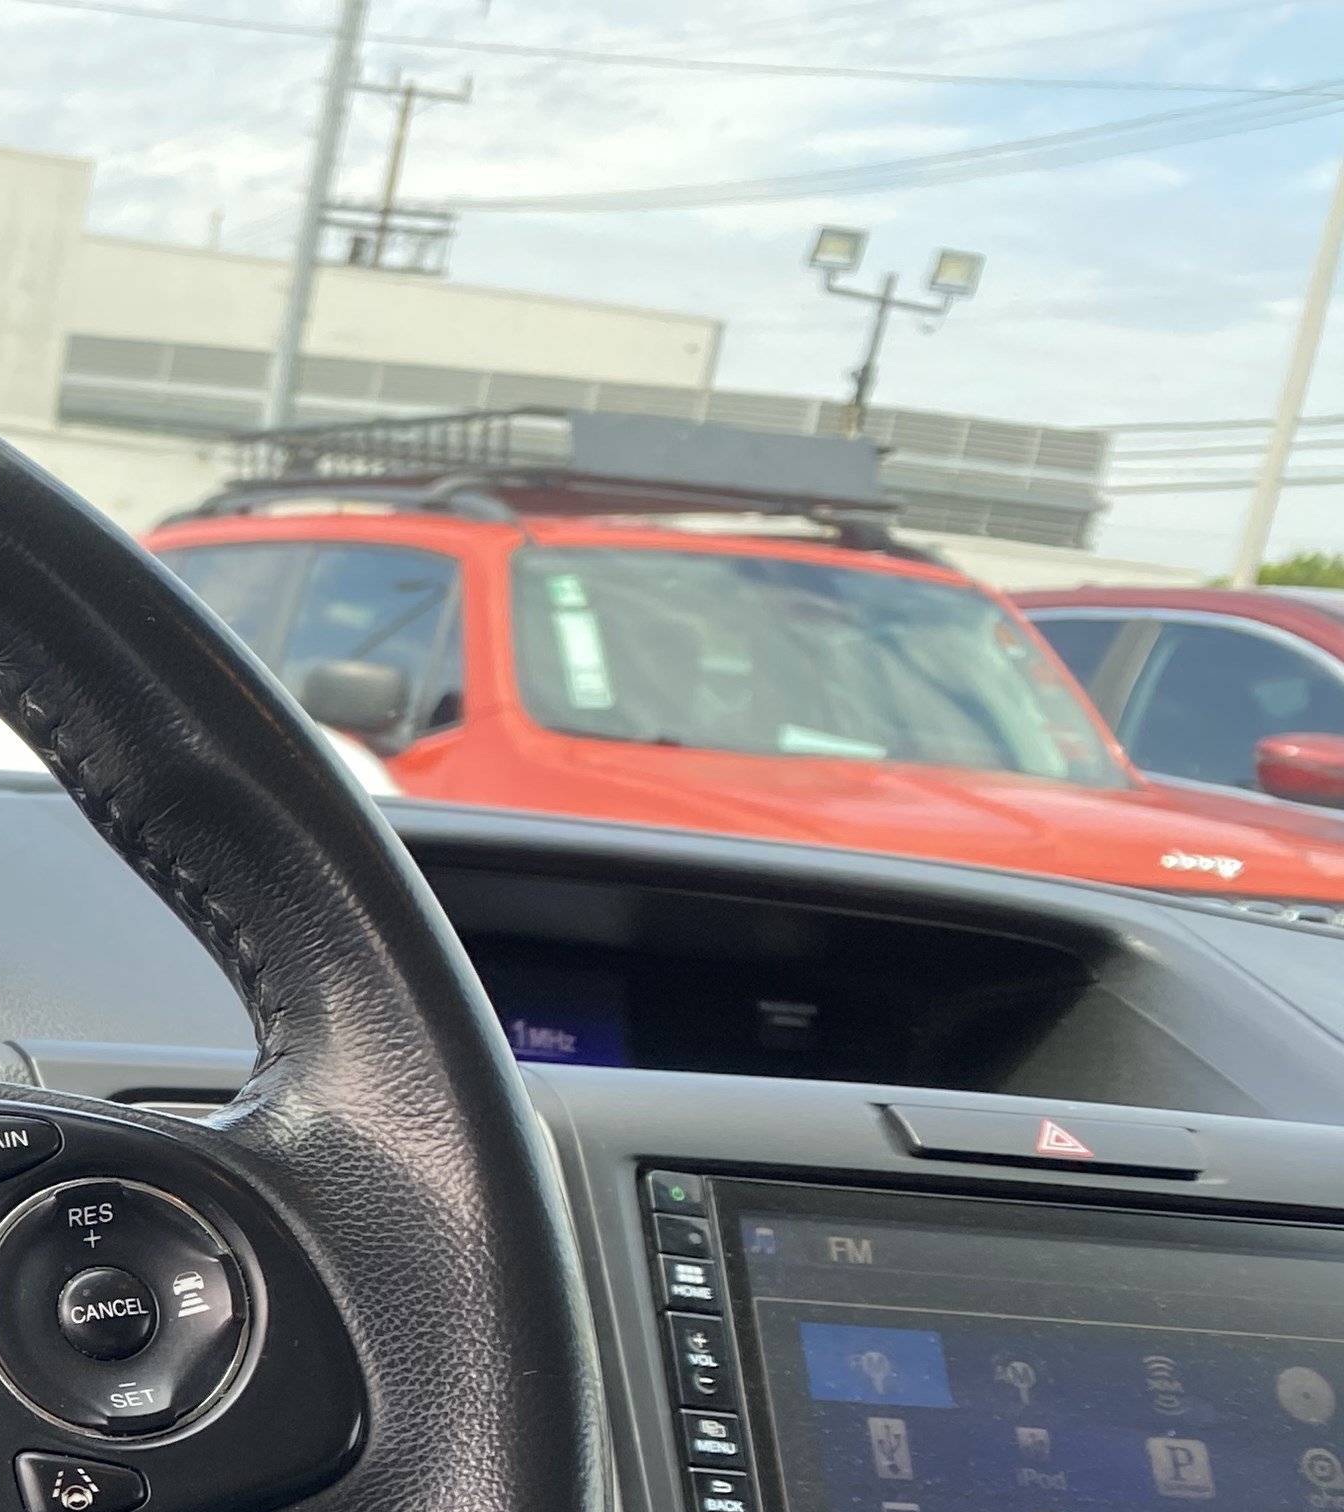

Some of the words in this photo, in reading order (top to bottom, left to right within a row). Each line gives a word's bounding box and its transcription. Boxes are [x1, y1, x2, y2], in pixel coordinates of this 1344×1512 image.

[528, 1027, 577, 1054] MHz
[68, 1203, 114, 1228] RES
[828, 1236, 874, 1265] FM
[671, 1283, 714, 1301] HOME
[71, 1297, 149, 1325] CANCEL
[687, 1353, 720, 1368] VOL
[110, 1388, 156, 1409] SET
[694, 1438, 737, 1456] MENU
[1016, 1467, 1068, 1491] iPod
